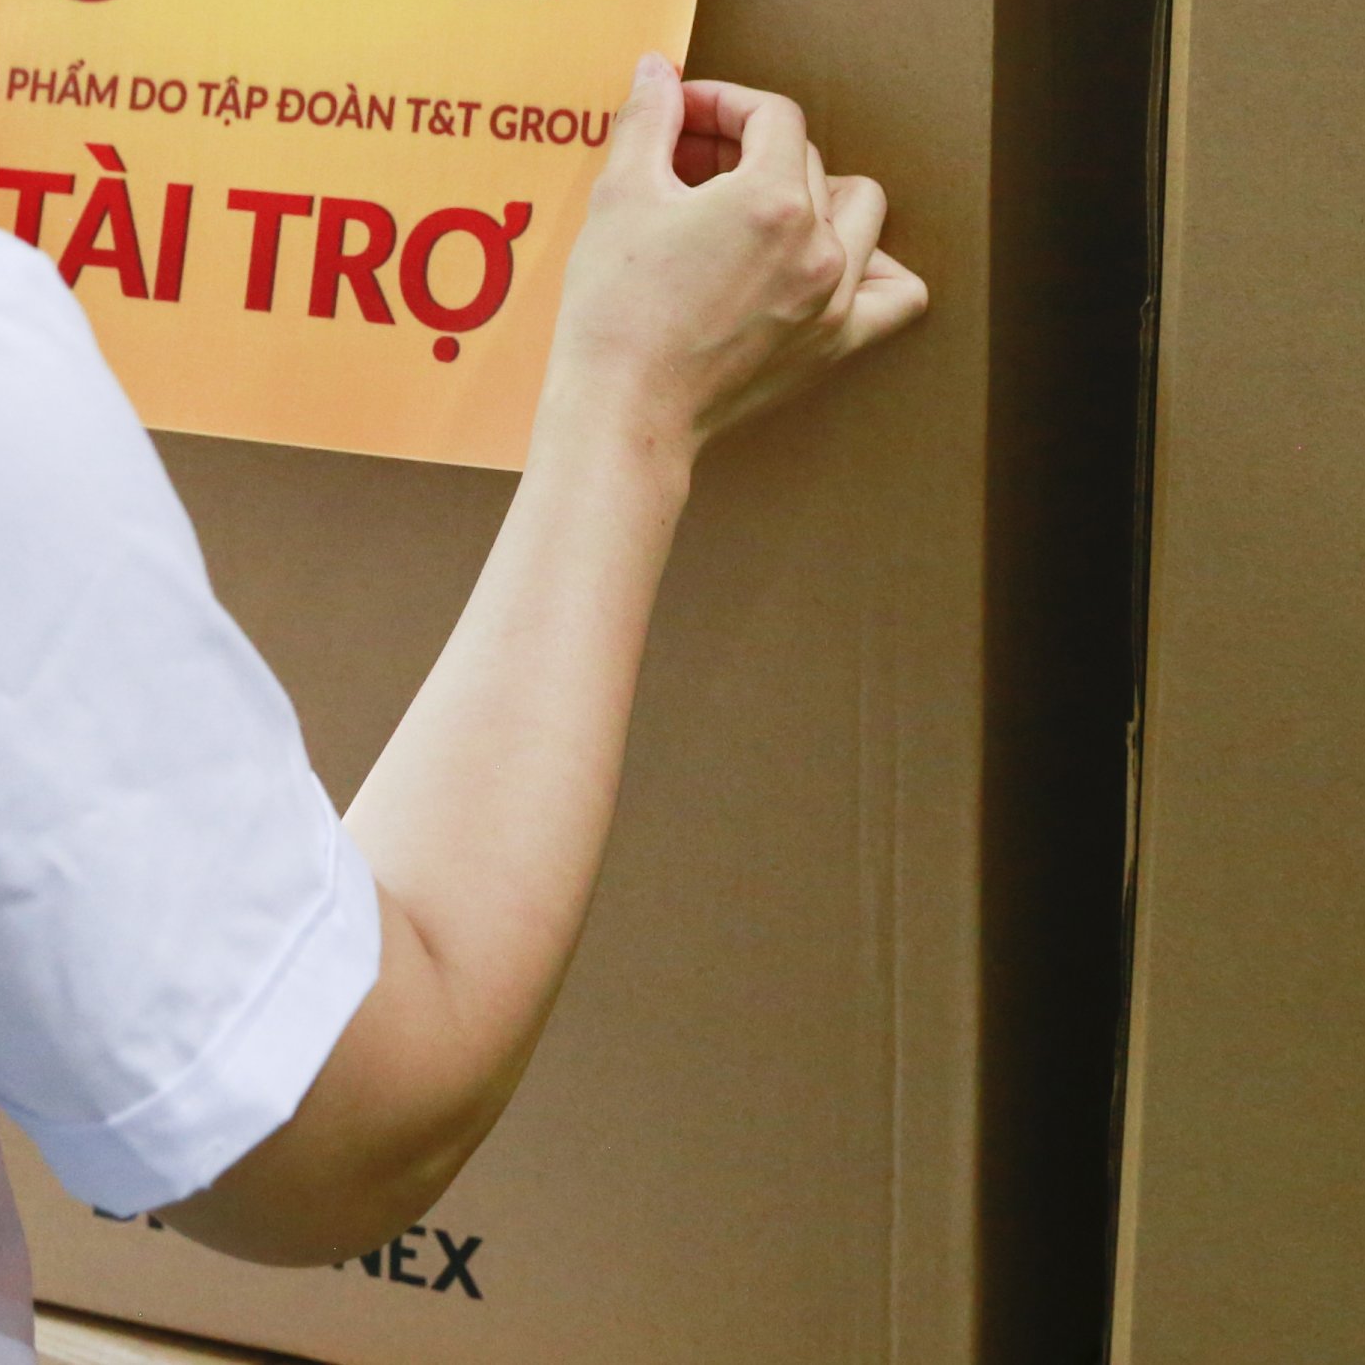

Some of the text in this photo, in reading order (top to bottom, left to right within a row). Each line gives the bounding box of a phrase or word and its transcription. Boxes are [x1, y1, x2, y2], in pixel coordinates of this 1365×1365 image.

[6, 58, 120, 110] PHẨM
[128, 76, 189, 115] DO
[197, 74, 270, 127] TẬP
[275, 82, 397, 132] ĐOÀN
[405, 96, 483, 138] T&T
[488, 103, 618, 149] GROU
[226, 187, 534, 364] TRỢ
